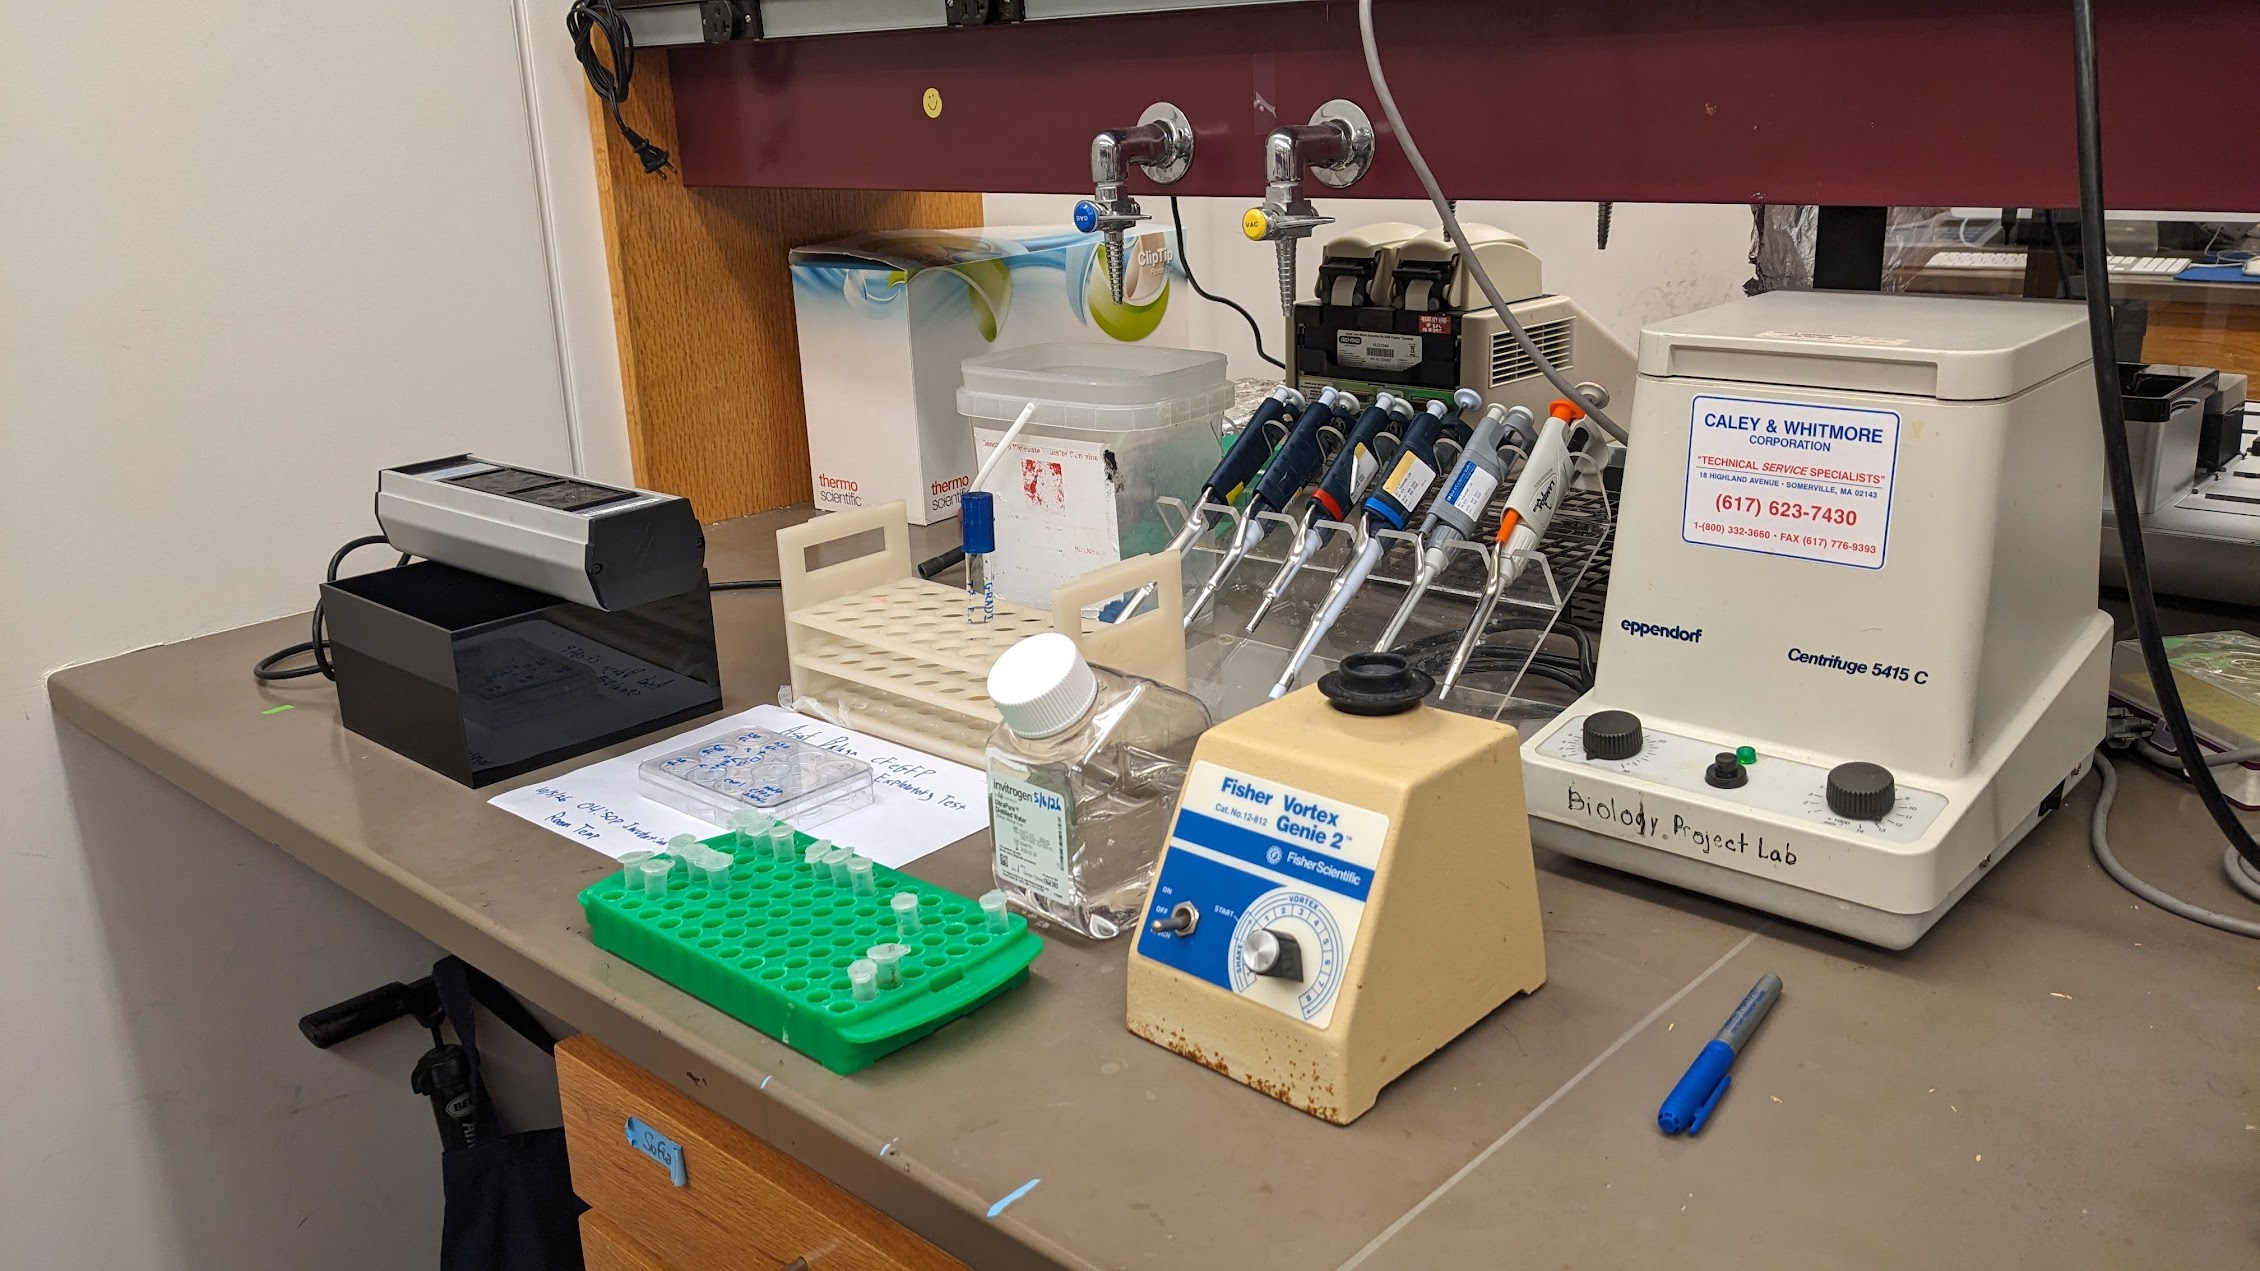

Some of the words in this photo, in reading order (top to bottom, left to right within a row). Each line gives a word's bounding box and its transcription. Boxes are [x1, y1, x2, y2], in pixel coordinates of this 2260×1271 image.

[1138, 248, 1173, 266] ClipTip
[1704, 413, 1761, 431] CALEY
[1766, 419, 1777, 433] &
[1784, 420, 1883, 443] WHITMORE
[1749, 435, 1831, 452] CORPORATION
[1762, 463, 1808, 476] SERVICE
[819, 473, 858, 492] thermo
[931, 475, 969, 495] thermo
[1709, 473, 1747, 483] HIGHLAND
[1749, 477, 1779, 487] AVENUE
[1786, 481, 1837, 495] SOMERVILLE,
[1840, 487, 1852, 496] MA
[1854, 489, 1878, 499] 02143
[820, 489, 862, 506] scientific
[1716, 493, 1762, 517] (617)
[1768, 500, 1858, 526] 623-7430
[1693, 522, 1725, 534] 1-(800)
[1727, 525, 1770, 539] 332-3660
[1780, 533, 1800, 543] FAX
[1802, 536, 1827, 548] (617)
[1831, 539, 1876, 554] 776-9393
[1621, 618, 1702, 644] eppendorf
[1787, 647, 1868, 675] Centrifuge
[1871, 664, 1910, 682] 5415
[1913, 670, 1929, 685] C
[993, 778, 1032, 802] invitrogen
[937, 794, 969, 811] Test
[1221, 776, 1273, 806] Fisher
[1284, 794, 1340, 827] Vortex
[1215, 803, 1230, 815] Cat.
[1243, 810, 1268, 826] 12-812
[544, 811, 572, 827] Room
[573, 823, 601, 840] Temp
[1276, 815, 1327, 843] Genie
[1567, 785, 1659, 837] Biology
[1673, 814, 1749, 854] Project
[1758, 837, 1798, 866] Lab
[1162, 885, 1173, 895] ON
[1155, 905, 1168, 915] OFF
[1214, 905, 1235, 918] START
[1288, 895, 1319, 911] VORTEX
[1313, 919, 1319, 927] 4
[1306, 994, 1312, 1002] 8
[643, 1132, 671, 1165] Sofia
